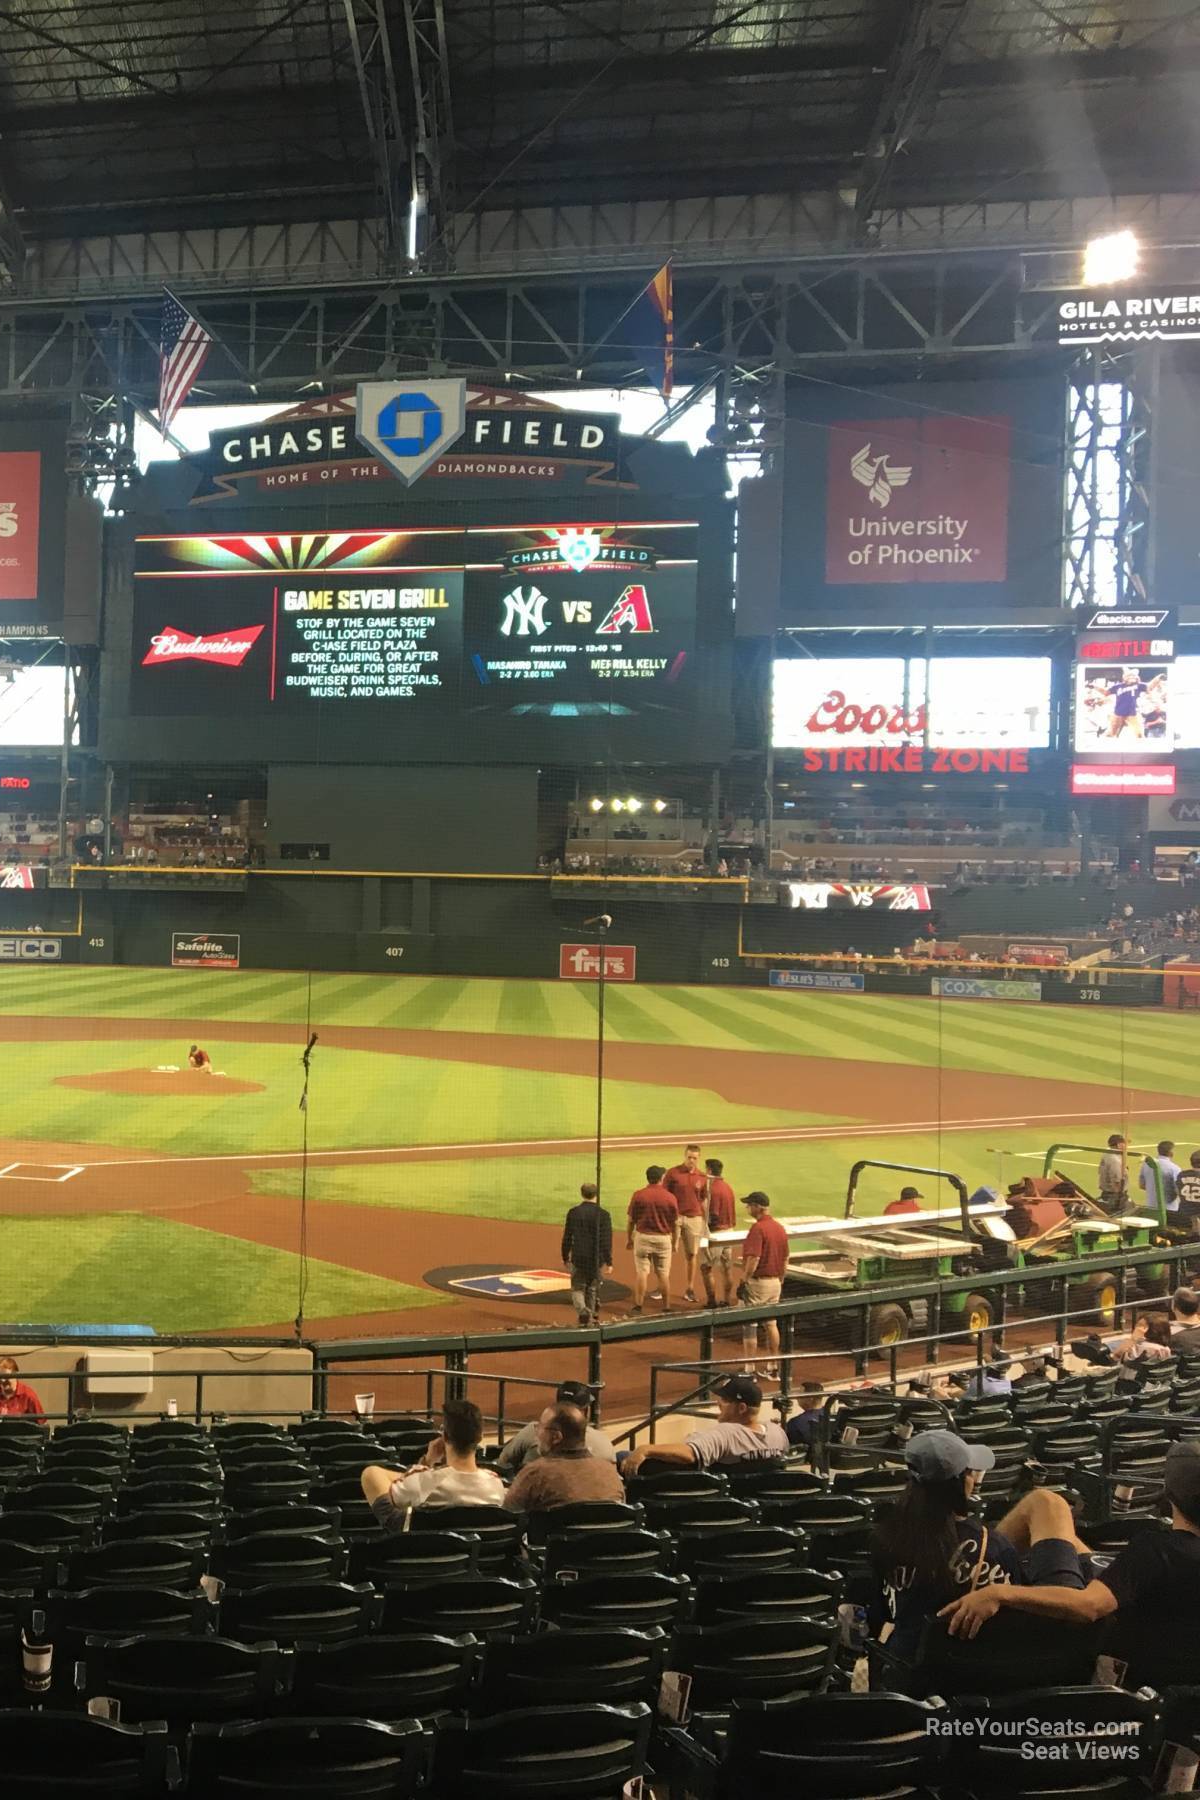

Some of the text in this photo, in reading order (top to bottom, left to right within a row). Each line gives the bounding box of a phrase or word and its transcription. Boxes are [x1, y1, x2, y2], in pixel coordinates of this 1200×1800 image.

[1059, 296, 1200, 319] GILA RIVER
[1059, 322, 1116, 331] HOTELS
[1124, 321, 1133, 329] &
[223, 420, 604, 462] CHASE FIELD
[267, 463, 555, 486] HOME OF THE DIAMONDBACKS
[849, 515, 968, 540] University
[512, 550, 648, 563] CHASE FIELD
[848, 544, 874, 565] of
[284, 588, 449, 611] GAME SEVEN GRILL
[563, 601, 592, 623] VS
[326, 618, 341, 628] BY
[343, 617, 364, 628] THE
[367, 617, 397, 627] GAME
[400, 616, 435, 627] SEVEN
[1097, 614, 1156, 624] dbacks.com
[303, 628, 427, 640] GRILL LOCATED ON THE
[151, 635, 252, 655] Budweiser
[351, 641, 381, 651] FIELD
[384, 640, 417, 650] PLAZA
[291, 651, 438, 664] BEFORE, DURING, OR AFTER
[307, 663, 422, 674] THE GAME FOR GREAT
[636, 659, 668, 669] KELLY
[286, 674, 442, 686] BUDWEISER DRINK SPECIALS,
[310, 686, 416, 698] MUSIC, AND GAMES.
[803, 747, 1029, 773] STRIKE ZONE
[0, 777, 30, 789] PATIO
[850, 891, 874, 907] VS
[89, 938, 104, 948] 413
[176, 941, 223, 952] Safelite
[385, 947, 403, 957] 407
[570, 948, 625, 975] fry's
[712, 958, 730, 968] 413
[943, 981, 1029, 997] COX COX
[1080, 989, 1101, 1001] 376
